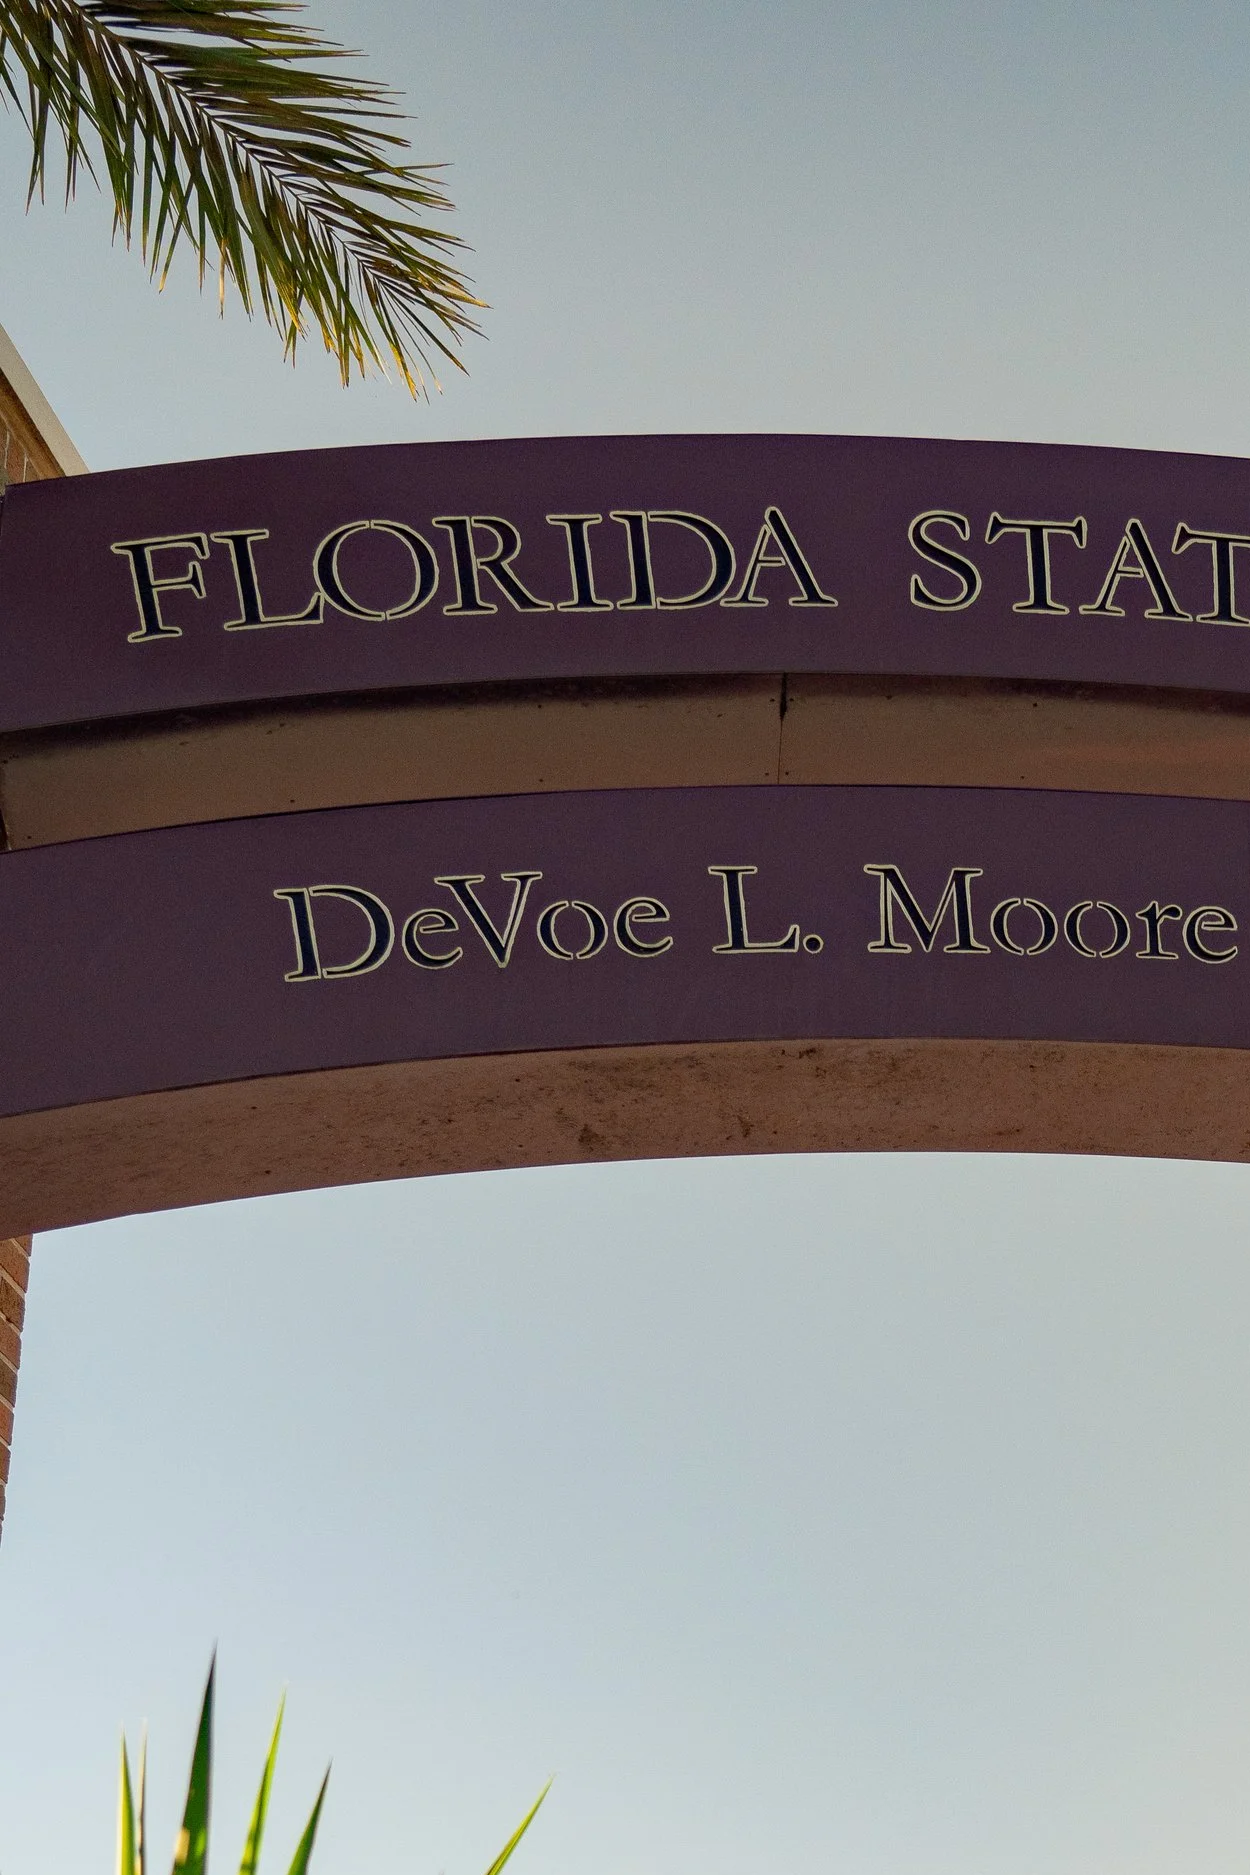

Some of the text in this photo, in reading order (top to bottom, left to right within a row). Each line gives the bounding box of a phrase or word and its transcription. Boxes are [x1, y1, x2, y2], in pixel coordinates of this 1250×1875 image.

[109, 505, 839, 644] FLORIDA
[272, 870, 674, 983] DeVoe
[707, 865, 825, 955] L.
[862, 863, 1239, 965] Moore
